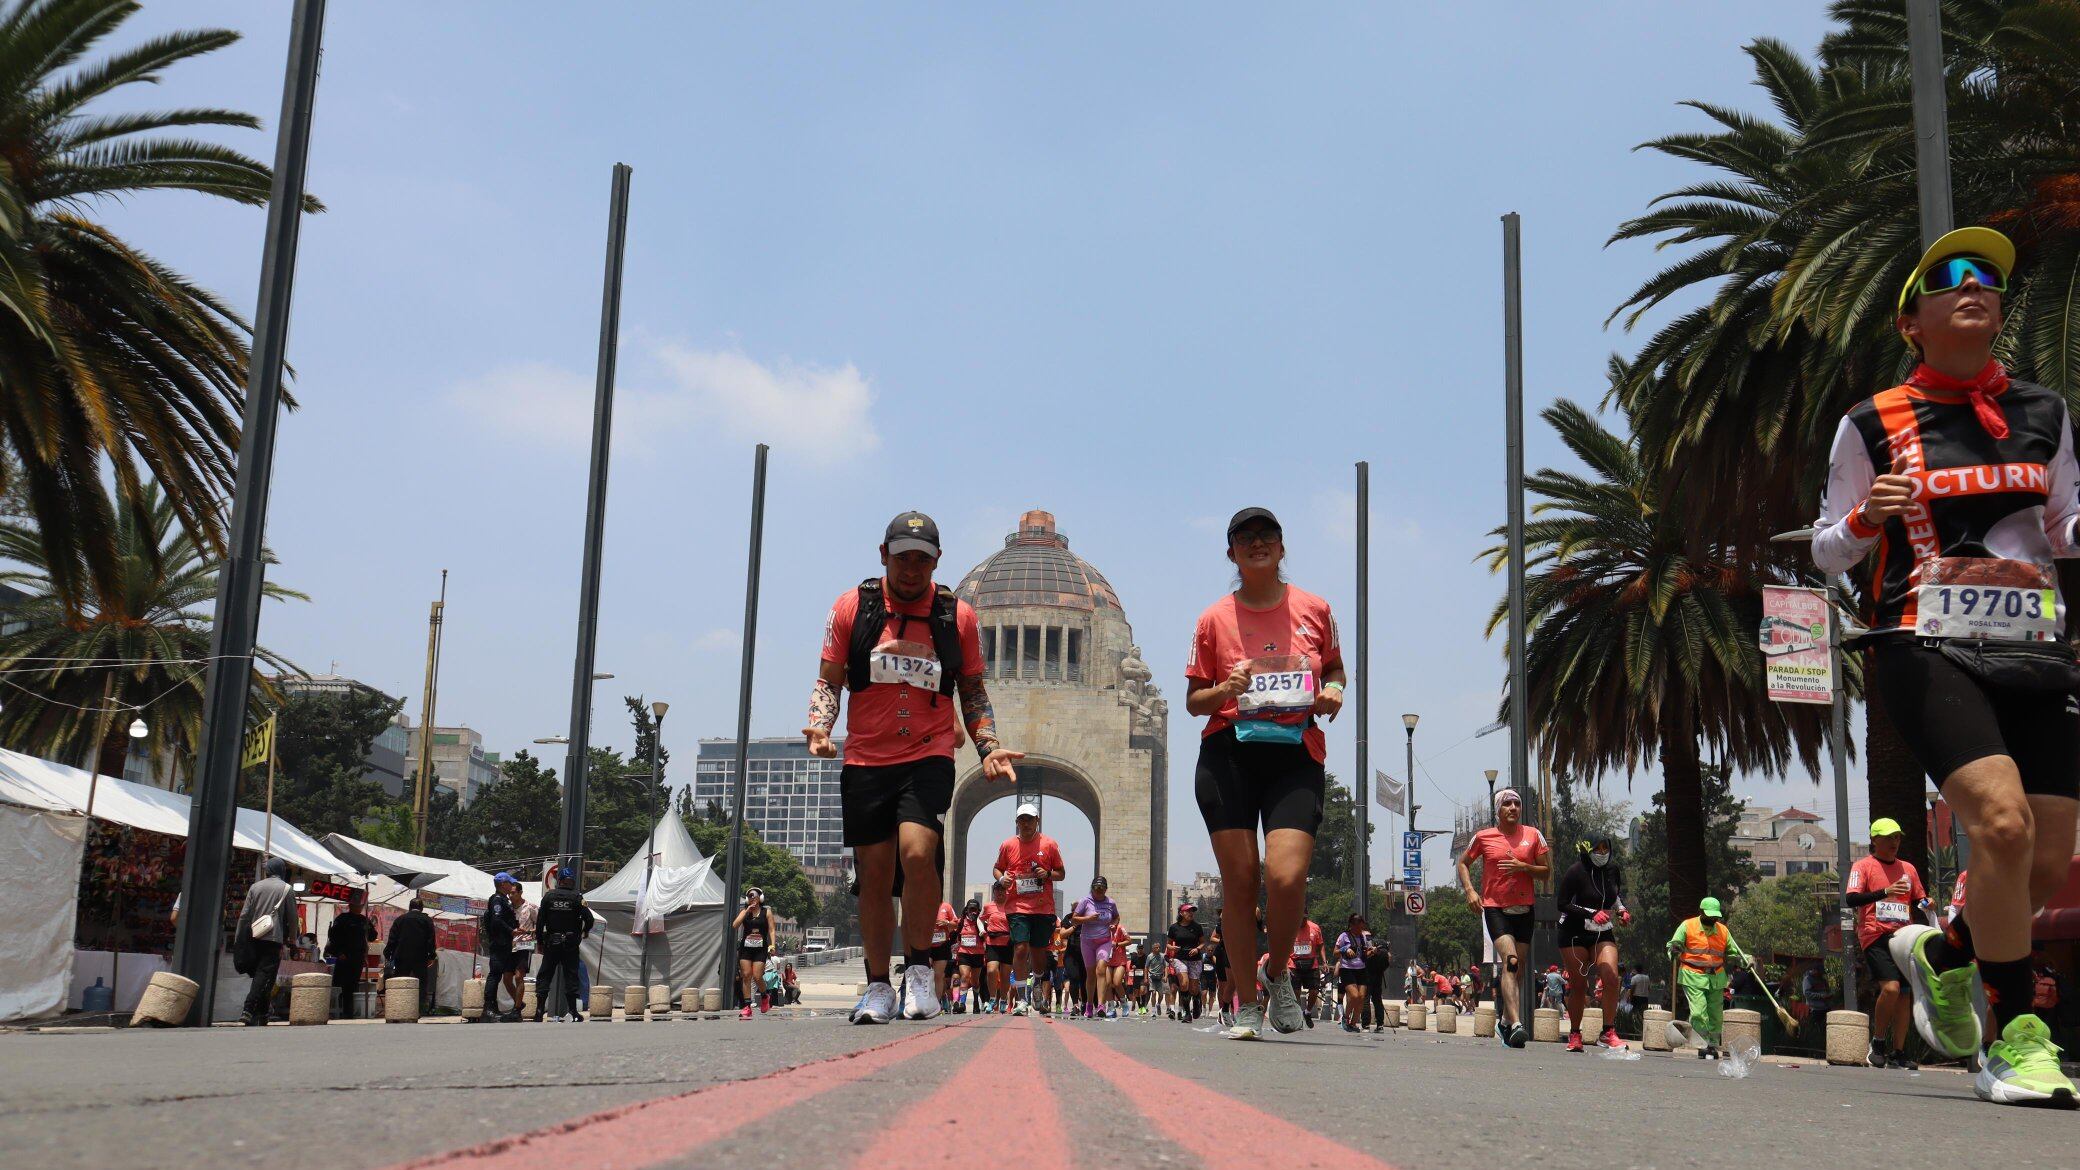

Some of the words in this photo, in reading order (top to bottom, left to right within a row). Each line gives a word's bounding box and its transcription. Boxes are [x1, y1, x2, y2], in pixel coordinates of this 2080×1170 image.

[1769, 600, 1818, 610] CAPITALBUS
[1939, 588, 2042, 619] 19703
[1969, 620, 2011, 628] ROSALINDA
[881, 655, 934, 676] 11372
[1768, 666, 1799, 674] PARADA
[1807, 668, 1826, 676] STOP
[1776, 674, 1820, 683] Monumento
[1786, 682, 1826, 692] Revolución
[1406, 837, 1419, 848] M
[1406, 852, 1419, 866] E
[1881, 903, 1907, 911] 26708
